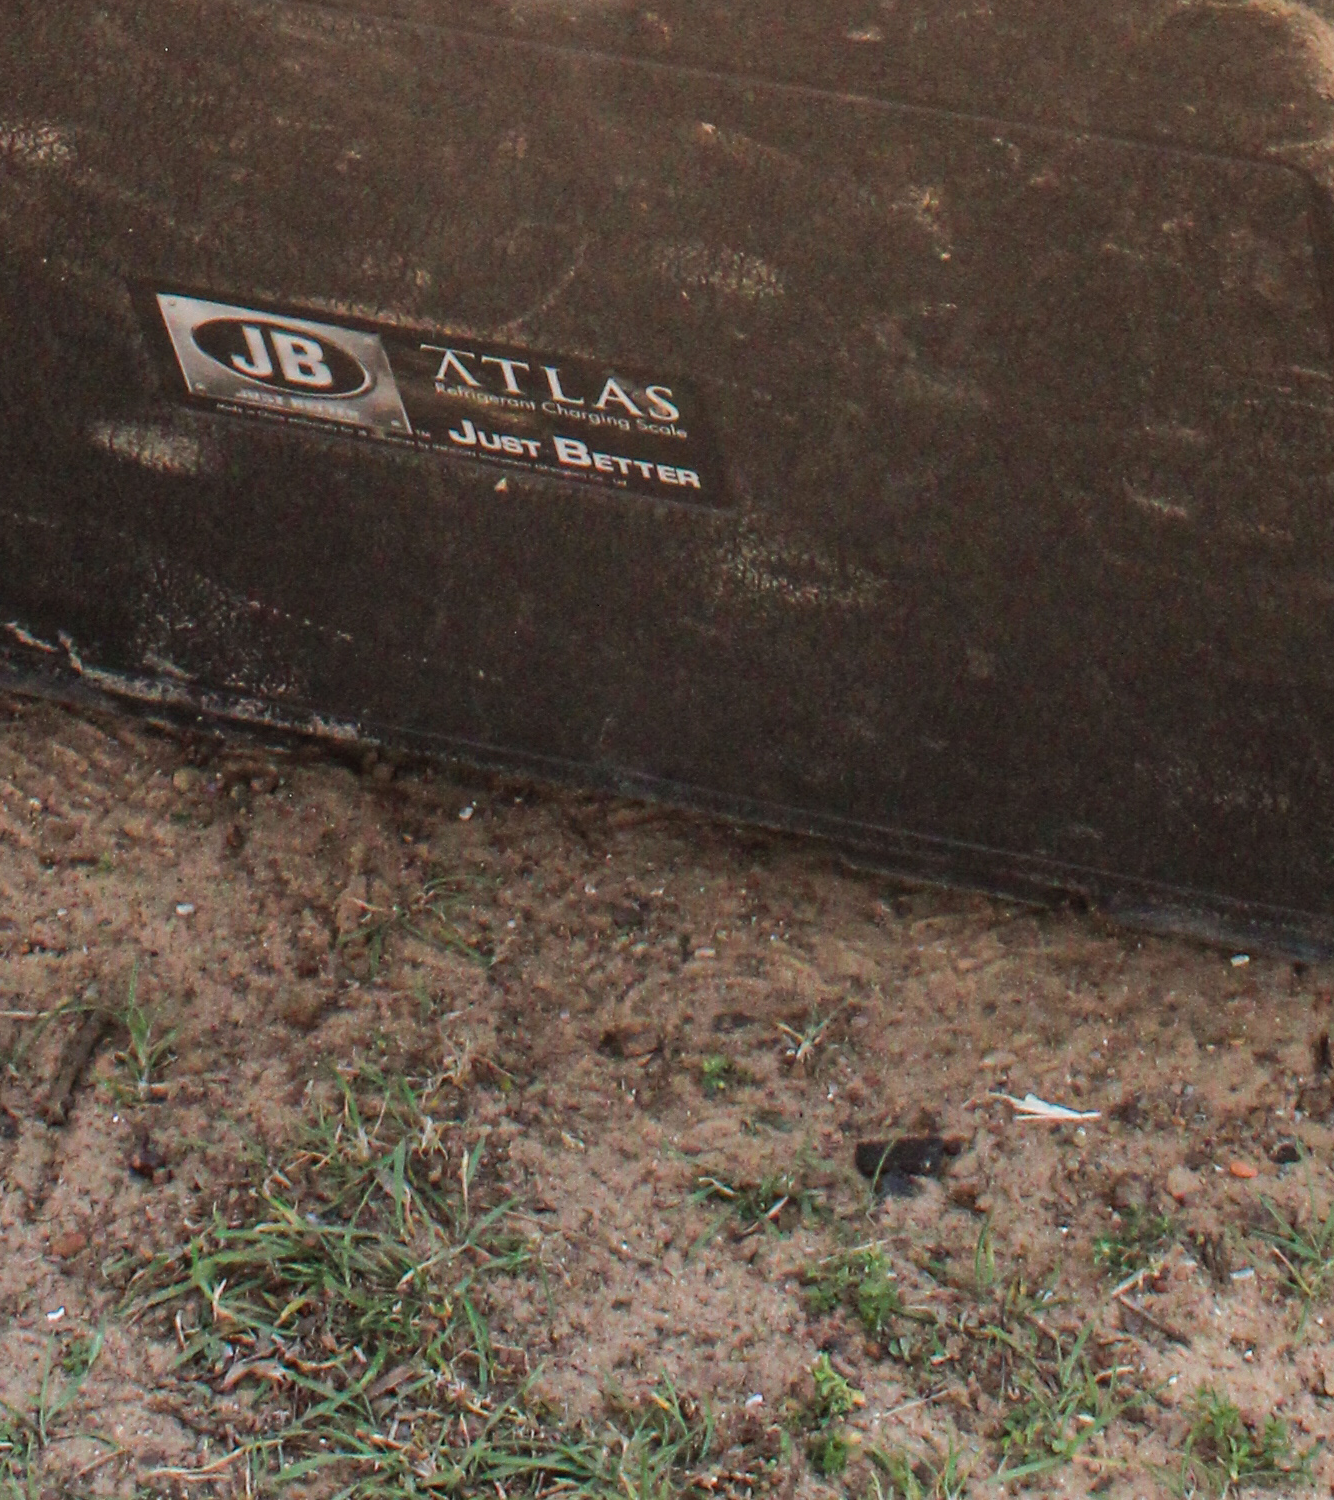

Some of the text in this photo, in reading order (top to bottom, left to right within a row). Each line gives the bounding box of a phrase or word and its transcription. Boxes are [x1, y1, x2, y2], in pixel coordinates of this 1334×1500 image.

[230, 324, 333, 387] JB
[420, 344, 680, 422] ATLAS
[435, 381, 688, 439] Refrigerant Charging Scale
